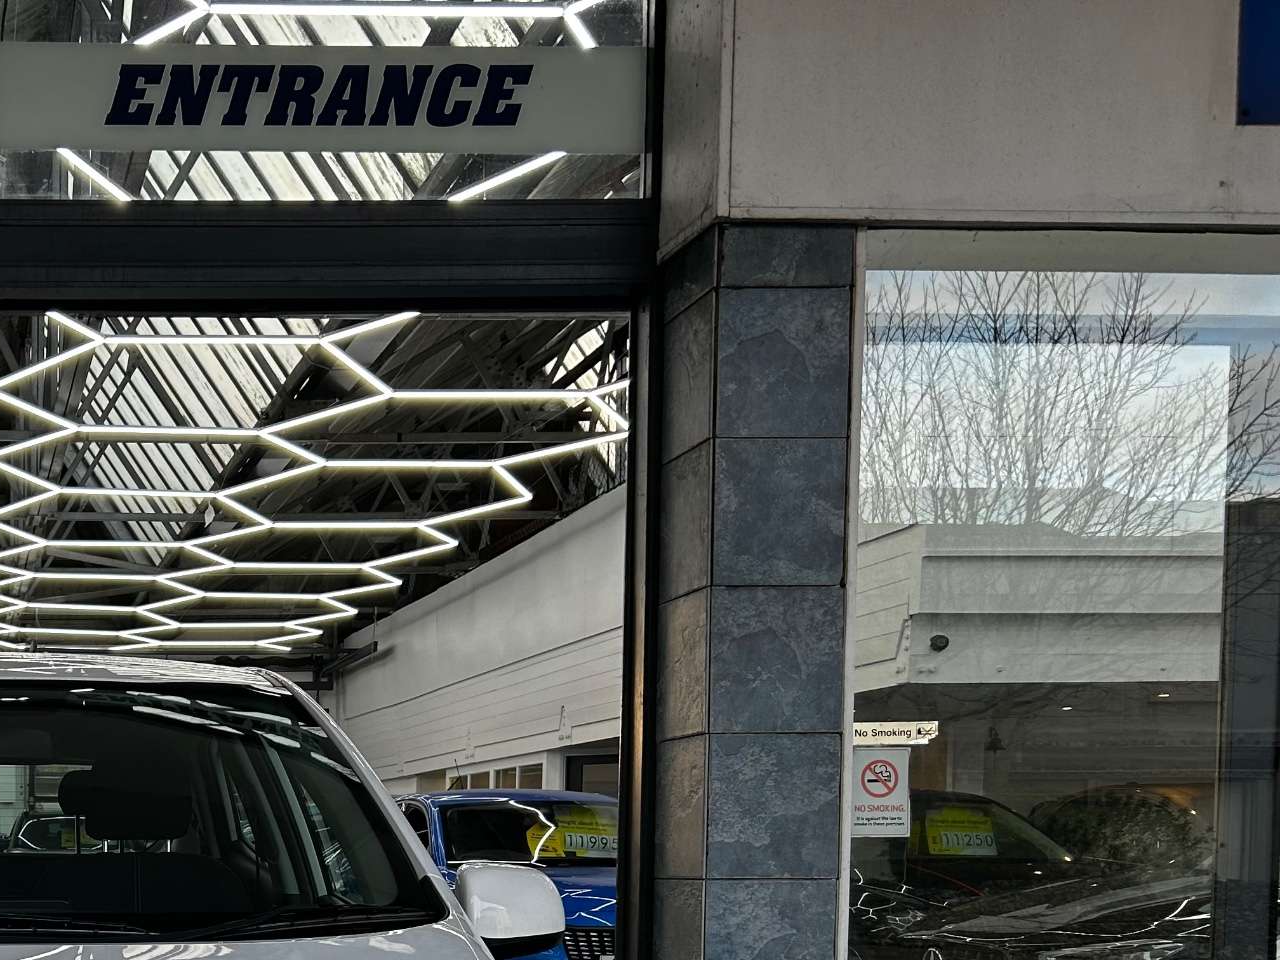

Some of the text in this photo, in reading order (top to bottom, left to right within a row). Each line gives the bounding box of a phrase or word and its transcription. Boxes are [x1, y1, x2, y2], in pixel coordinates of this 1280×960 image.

[104, 63, 534, 128] ENTRANCE
[854, 728, 912, 738] No Smoking
[854, 804, 866, 813] NO
